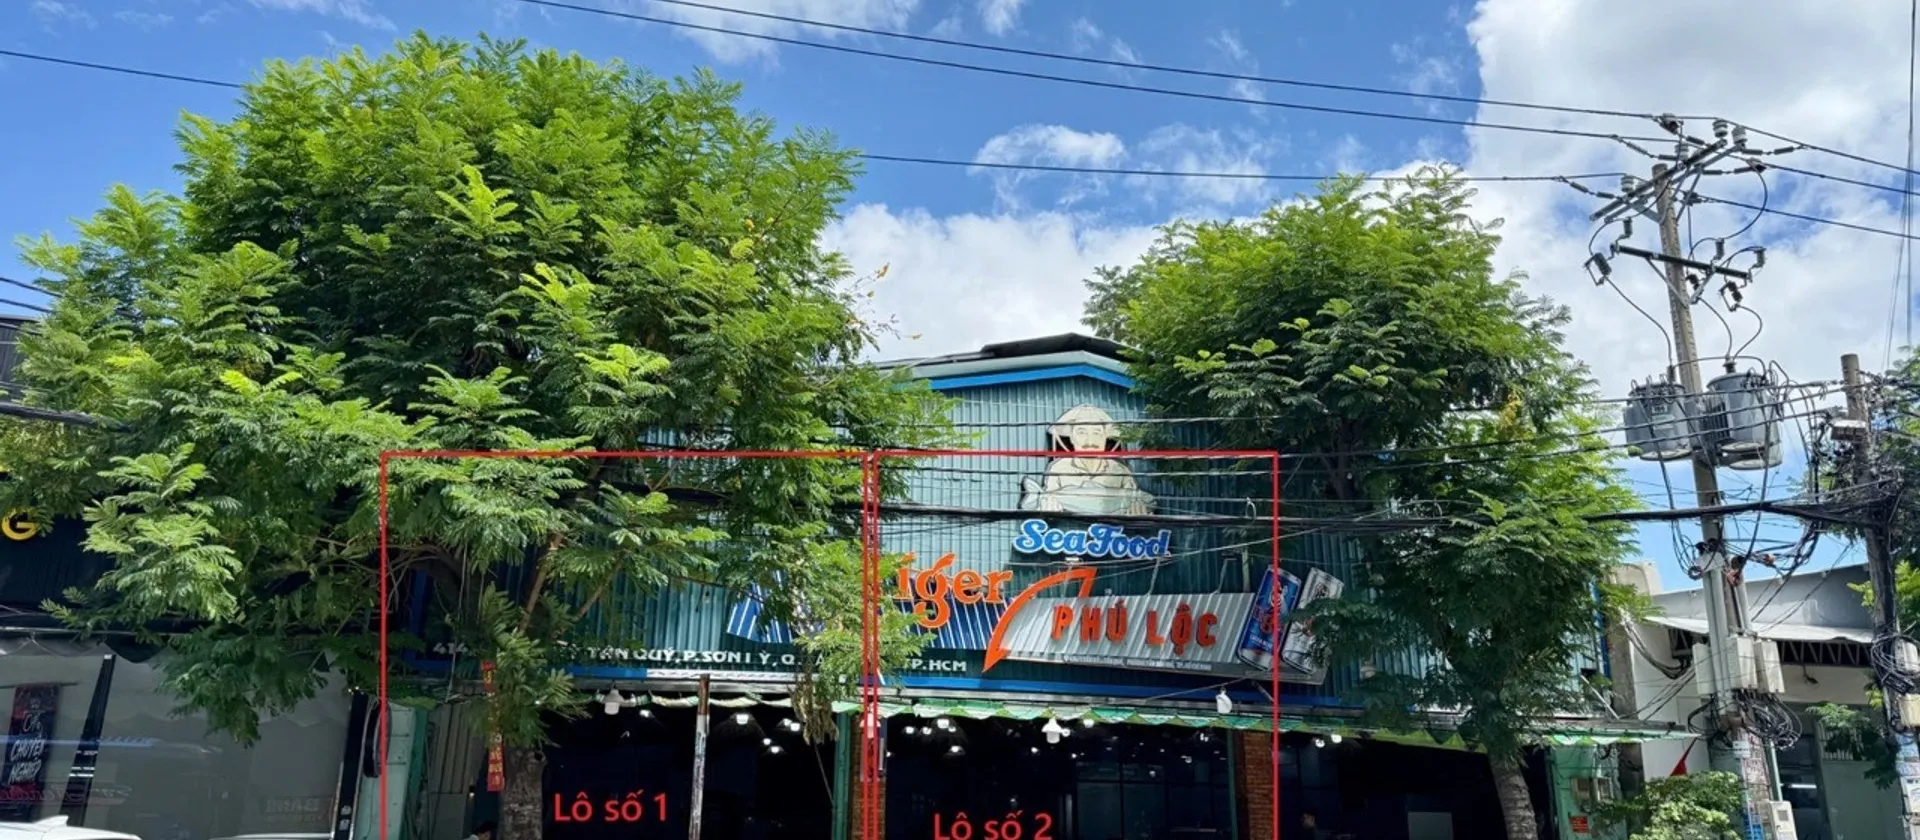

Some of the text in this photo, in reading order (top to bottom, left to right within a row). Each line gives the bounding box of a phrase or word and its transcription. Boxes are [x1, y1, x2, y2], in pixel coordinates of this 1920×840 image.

[1, 506, 38, 541] G
[1013, 518, 1172, 559] SeaFood
[892, 551, 1014, 629] iger
[1051, 599, 1128, 643] PHÚ
[1146, 602, 1218, 656] LỘC
